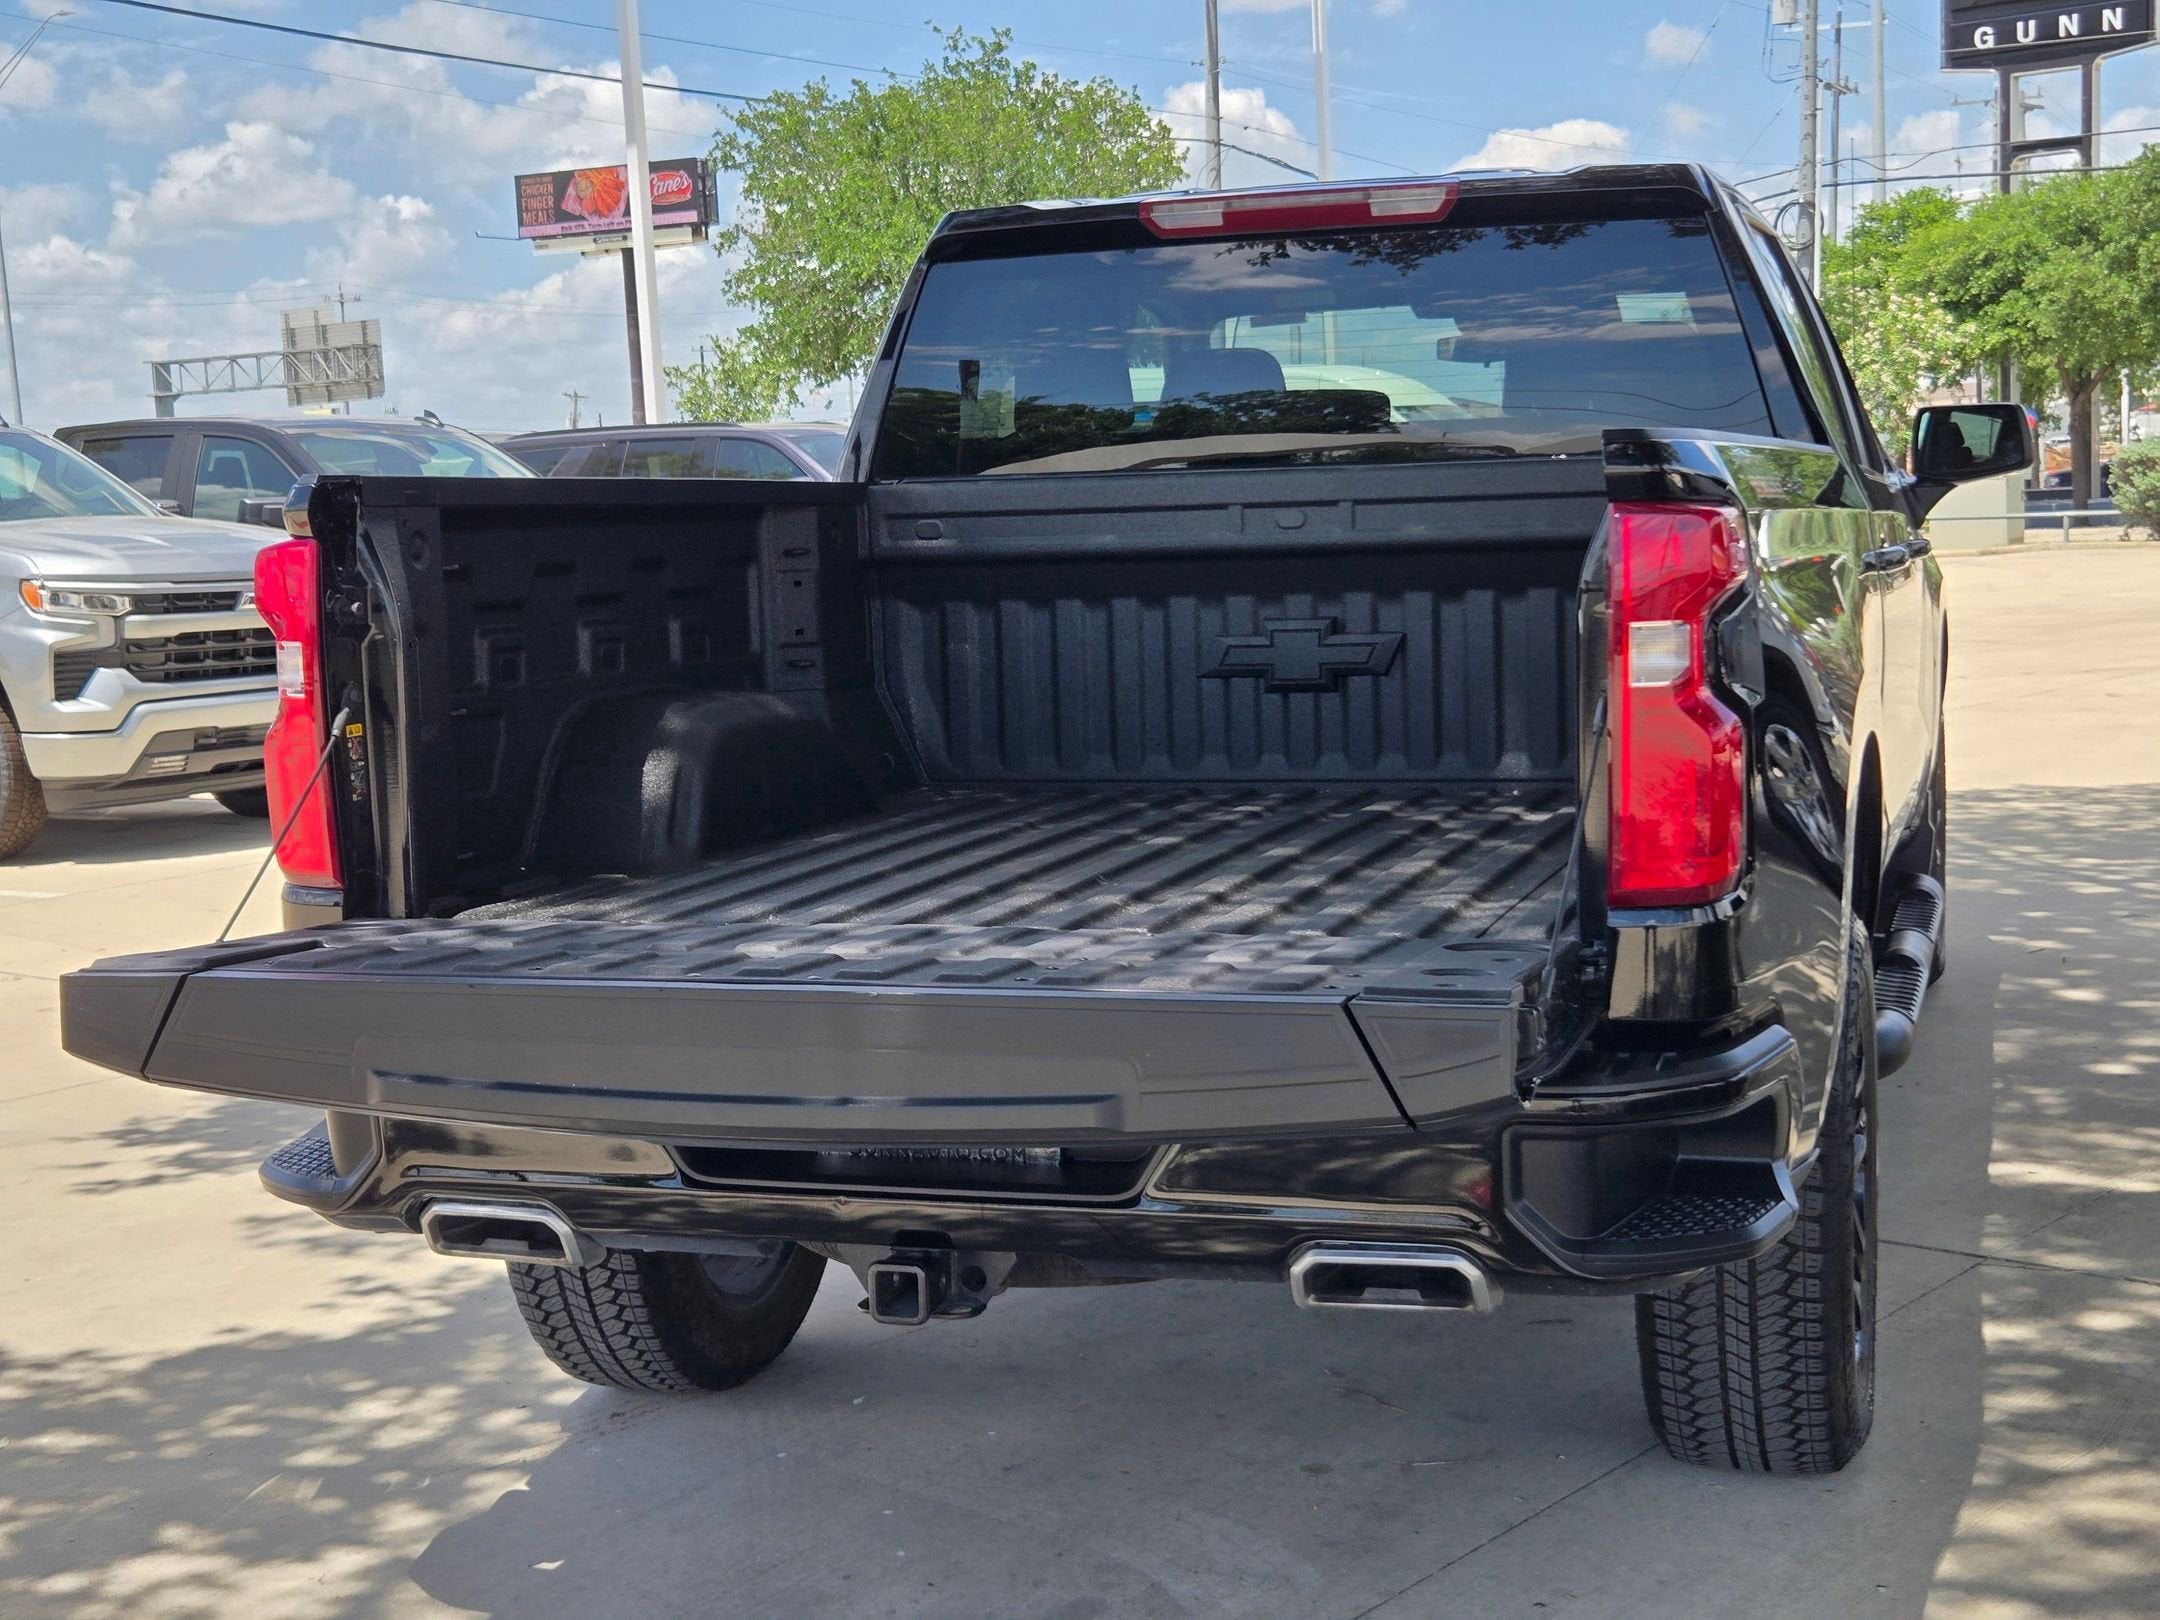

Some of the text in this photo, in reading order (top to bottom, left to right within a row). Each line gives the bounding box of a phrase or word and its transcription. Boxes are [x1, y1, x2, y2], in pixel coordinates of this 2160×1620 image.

[1973, 7, 2124, 50] GUNN
[521, 183, 554, 197] CHICKEN
[521, 195, 554, 211] FINGER
[522, 209, 556, 226] MEALS
